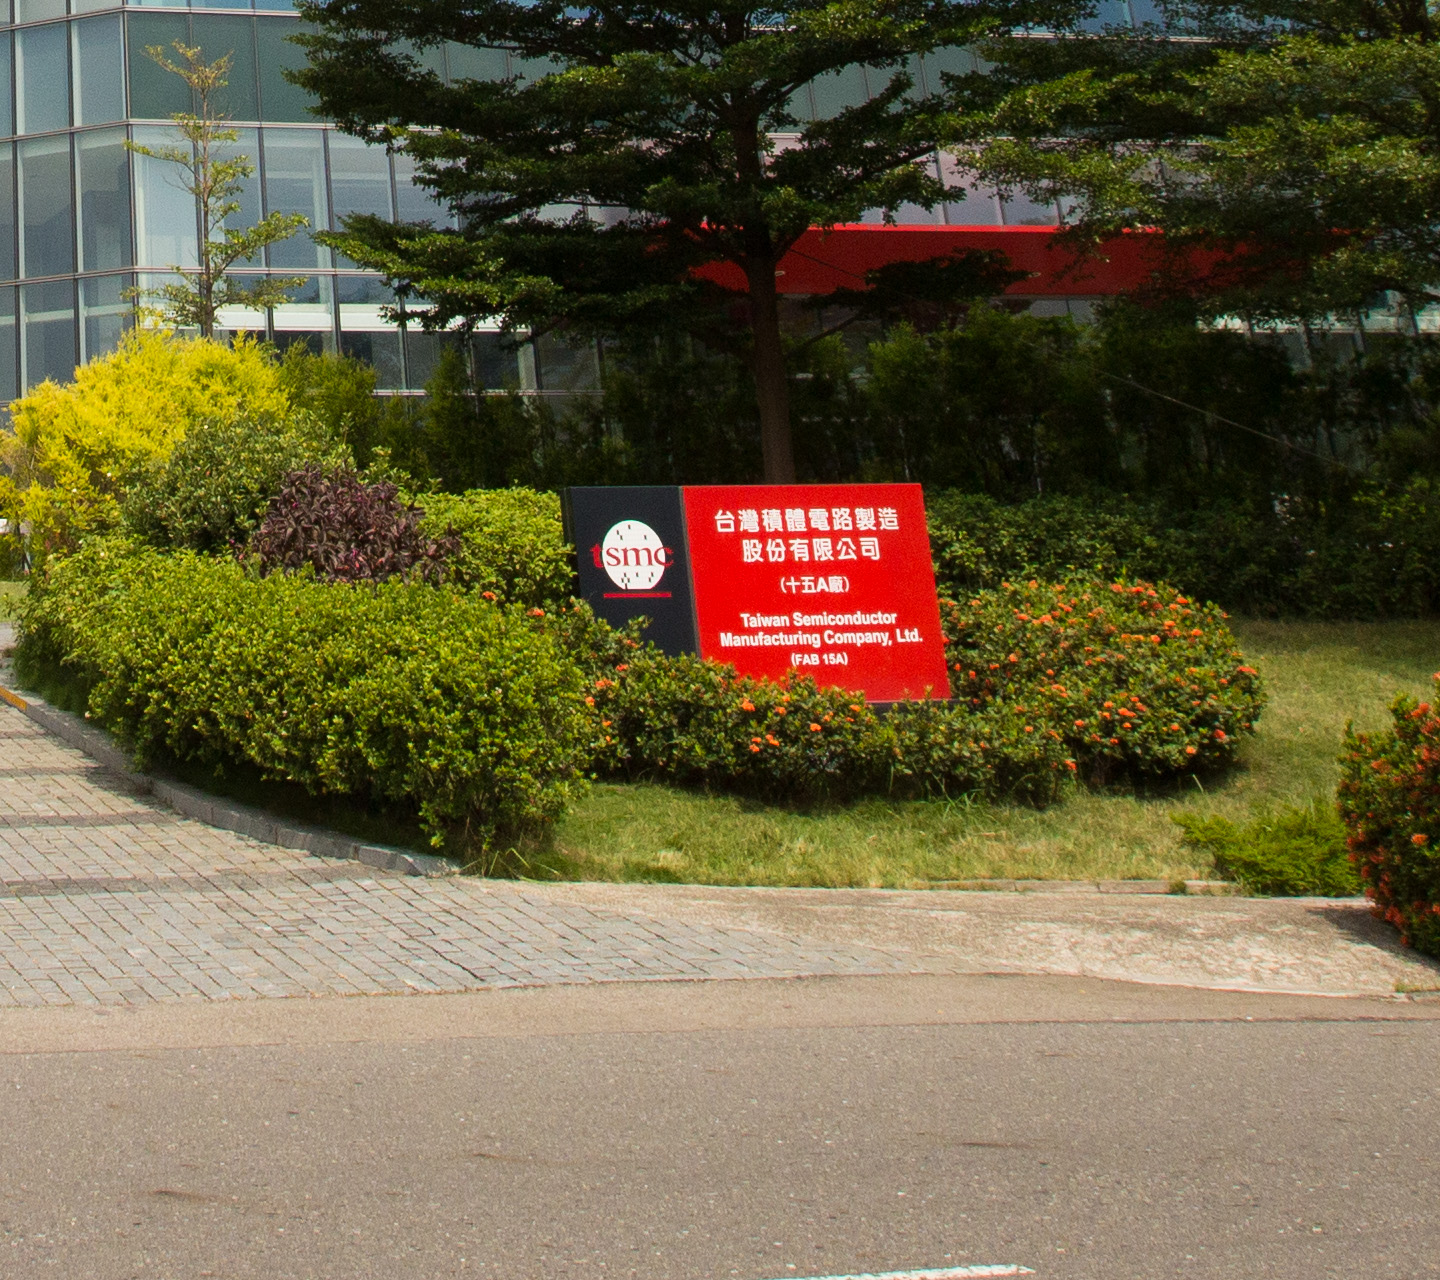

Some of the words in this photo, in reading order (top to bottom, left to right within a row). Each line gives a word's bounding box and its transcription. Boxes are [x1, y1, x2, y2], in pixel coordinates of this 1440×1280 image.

[714, 507, 900, 533] 台灣積體電路製造
[590, 543, 674, 568] tsmc
[742, 537, 881, 563] 股份有限公司
[740, 612, 790, 628] Taiwan
[793, 610, 897, 627] Semiconductor
[720, 631, 821, 648] Manufacturing
[824, 629, 893, 647] Company,
[896, 627, 924, 643] Ltd.
[791, 652, 820, 667] (FAB
[822, 651, 849, 666] 15A)
